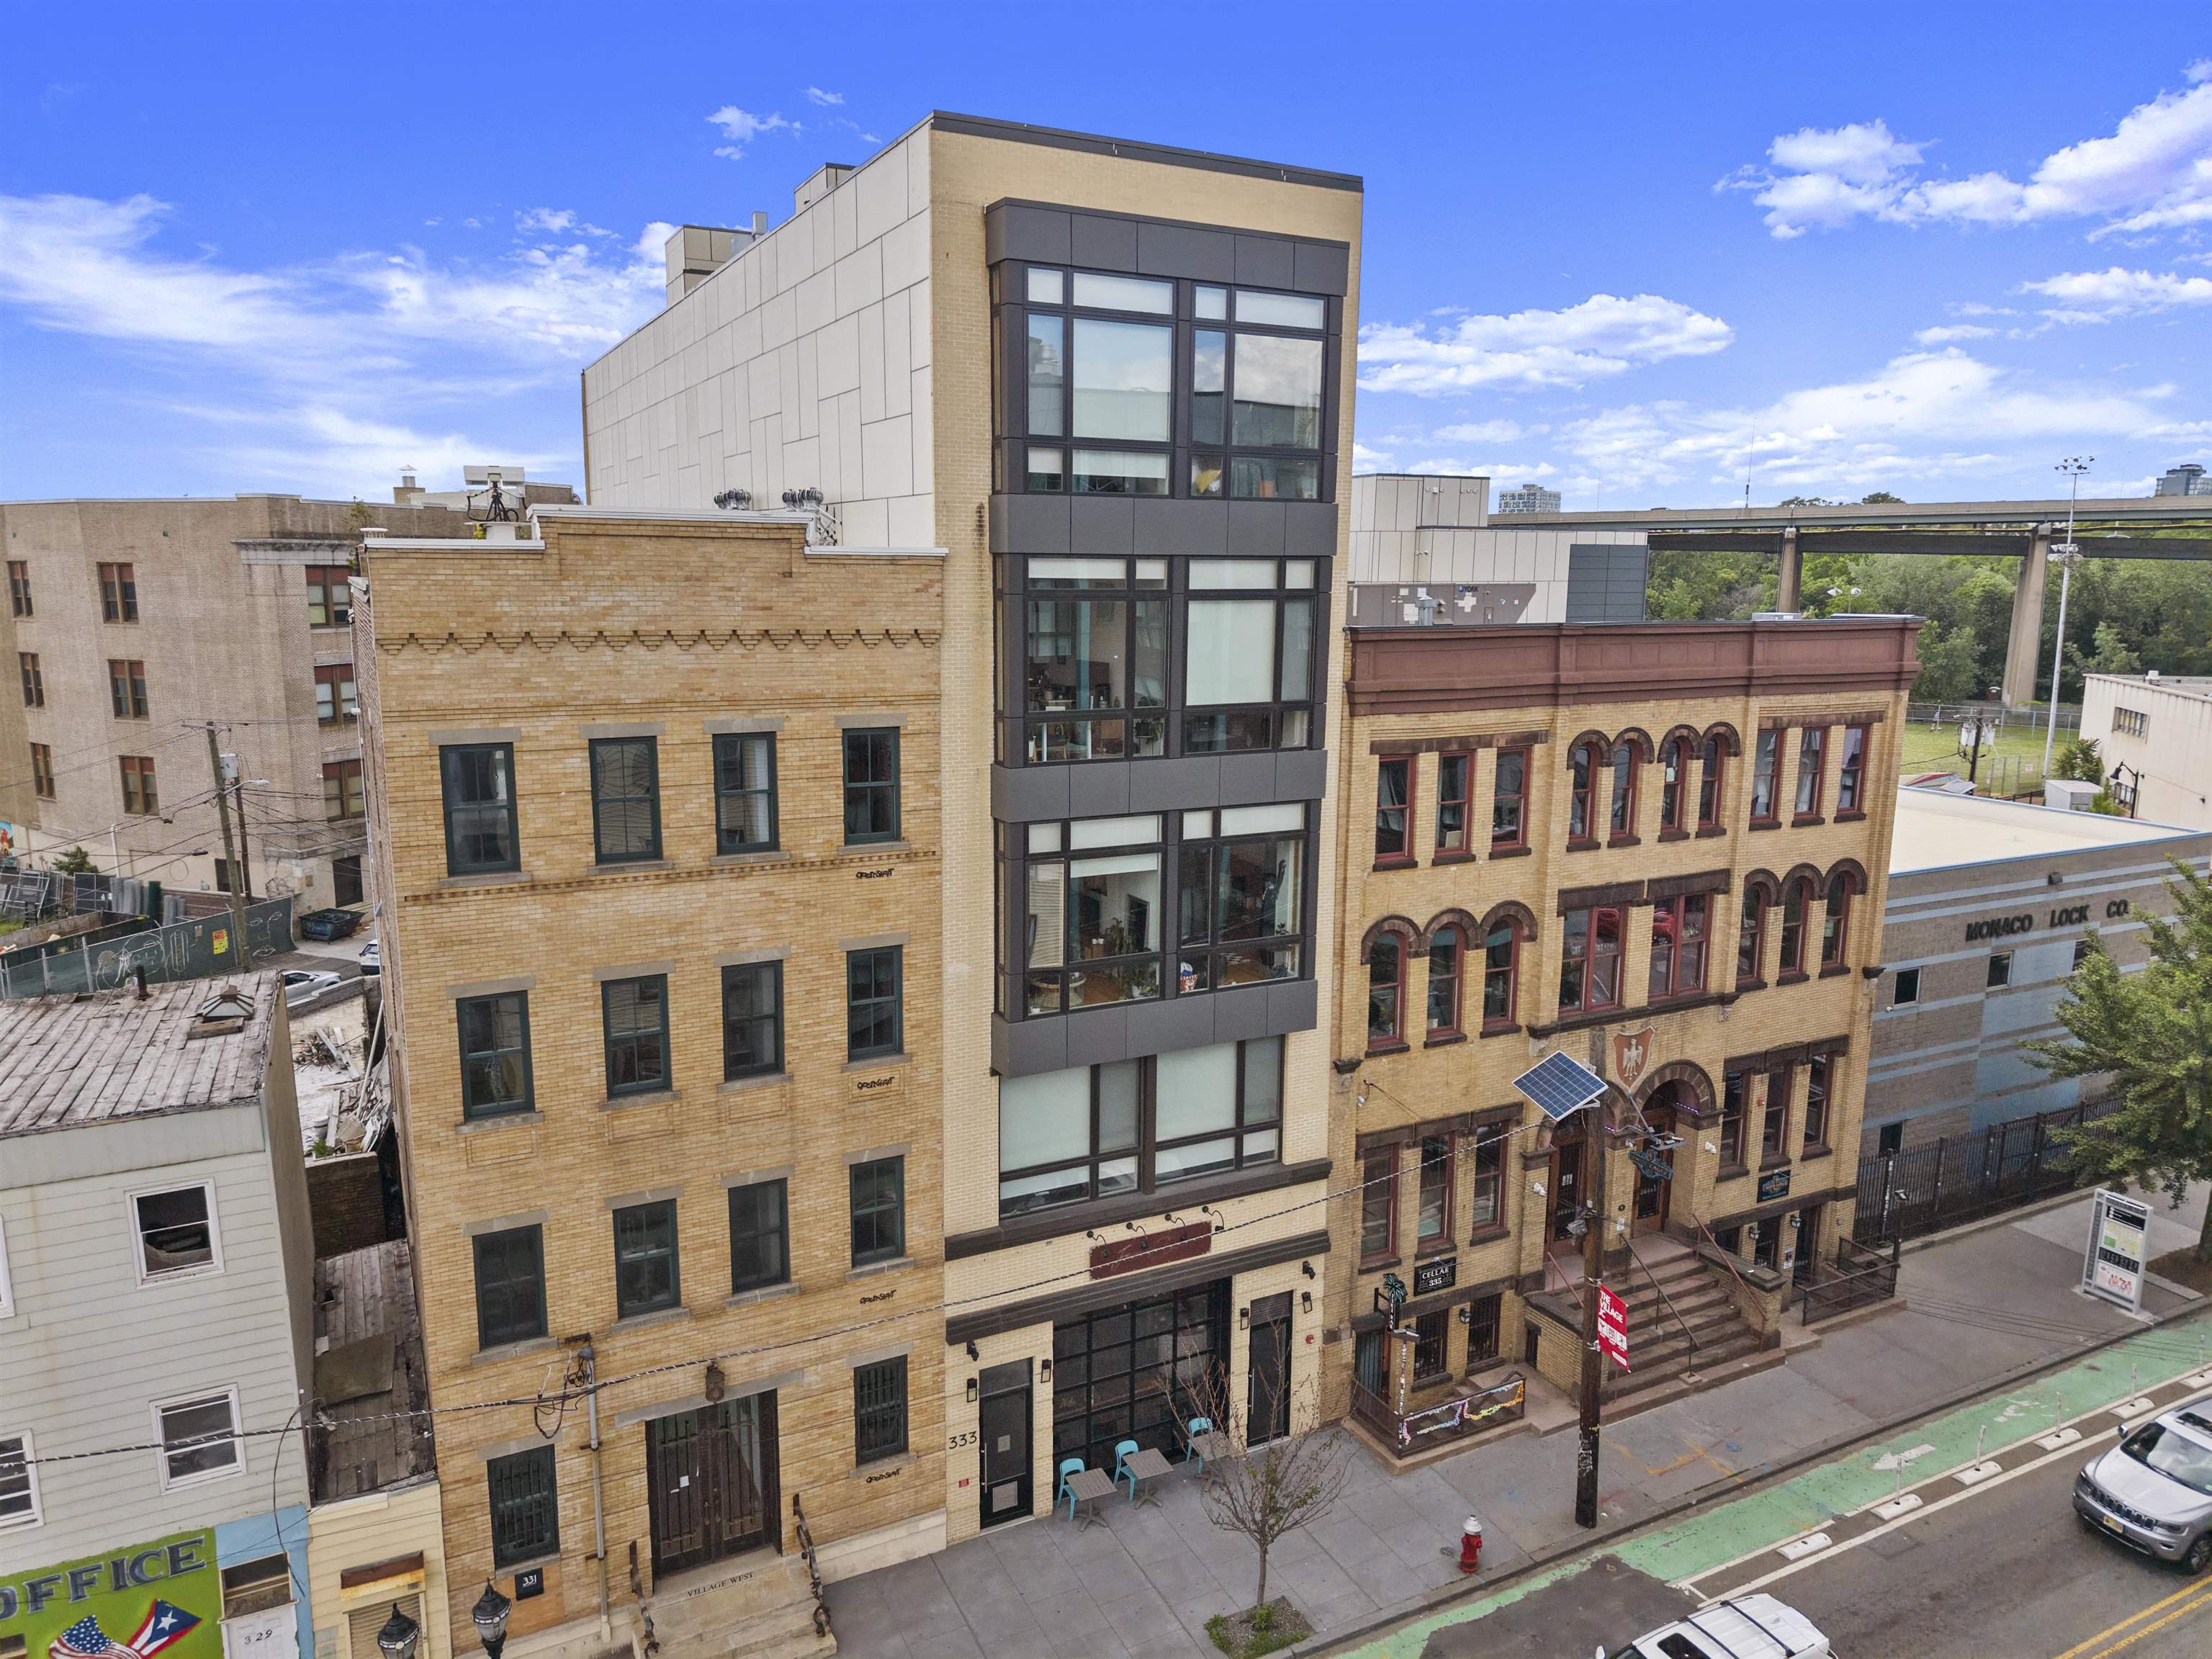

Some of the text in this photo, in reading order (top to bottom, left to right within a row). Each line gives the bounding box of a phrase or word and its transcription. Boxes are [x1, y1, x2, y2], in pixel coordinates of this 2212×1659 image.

[1965, 914, 2033, 942] MONACO
[2049, 904, 2090, 927] LOCK
[1422, 1267, 1449, 1279] CELLAR
[1429, 1277, 1442, 1287] 335
[1601, 1290, 1611, 1305] THE
[1600, 1298, 1623, 1323] VILLAGE
[949, 1431, 978, 1449] 333
[523, 1574, 536, 1586] 331
[687, 1572, 754, 1596] VILLAGE WEST
[245, 1629, 272, 1645] 329
